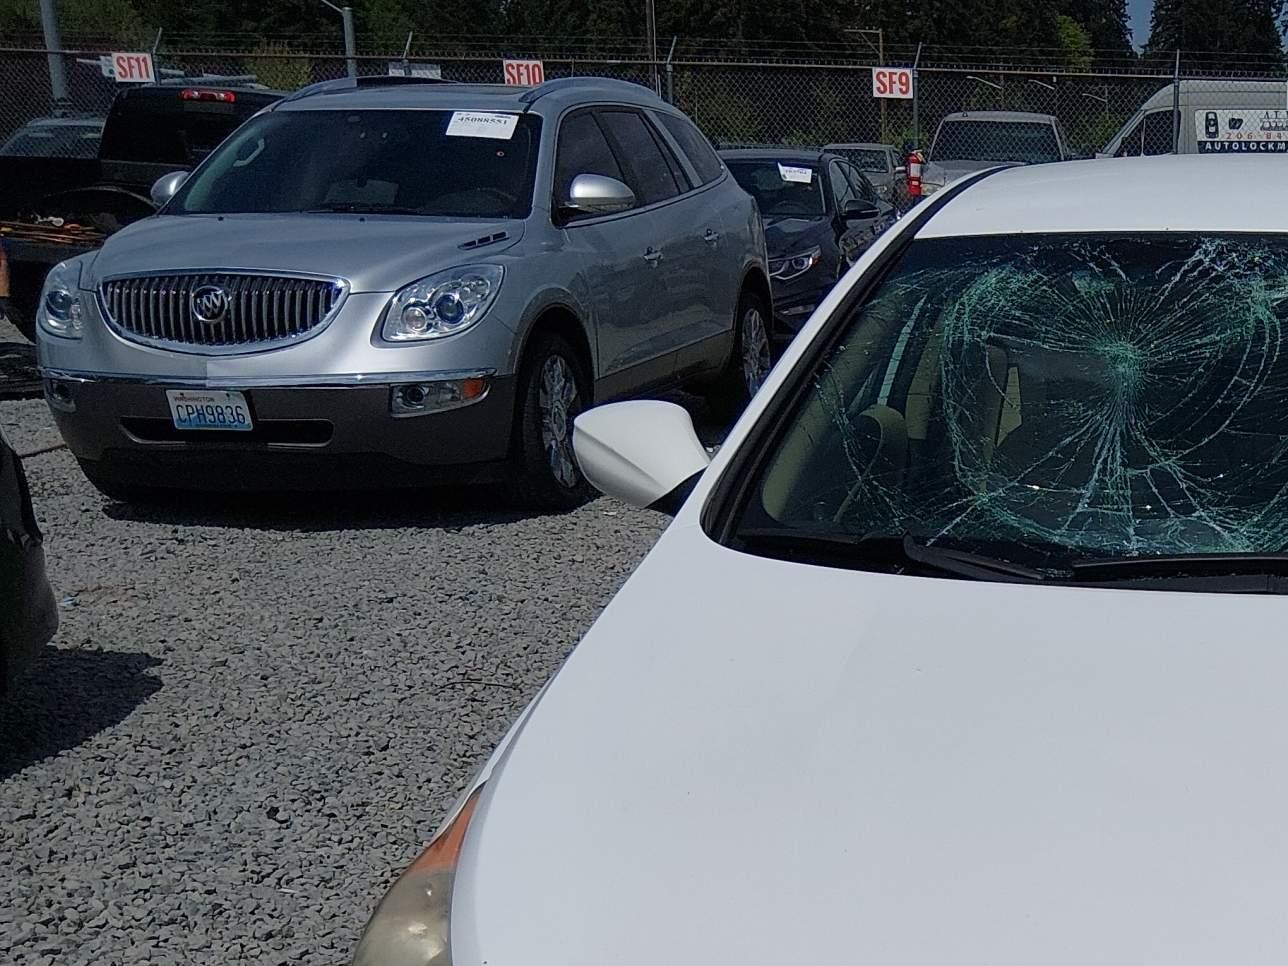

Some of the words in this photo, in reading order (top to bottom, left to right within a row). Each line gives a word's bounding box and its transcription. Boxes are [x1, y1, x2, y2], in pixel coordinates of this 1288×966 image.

[116, 56, 150, 79] SF11
[505, 63, 543, 85] SF10
[875, 71, 910, 95] SF9
[176, 404, 246, 425] CPH9836
